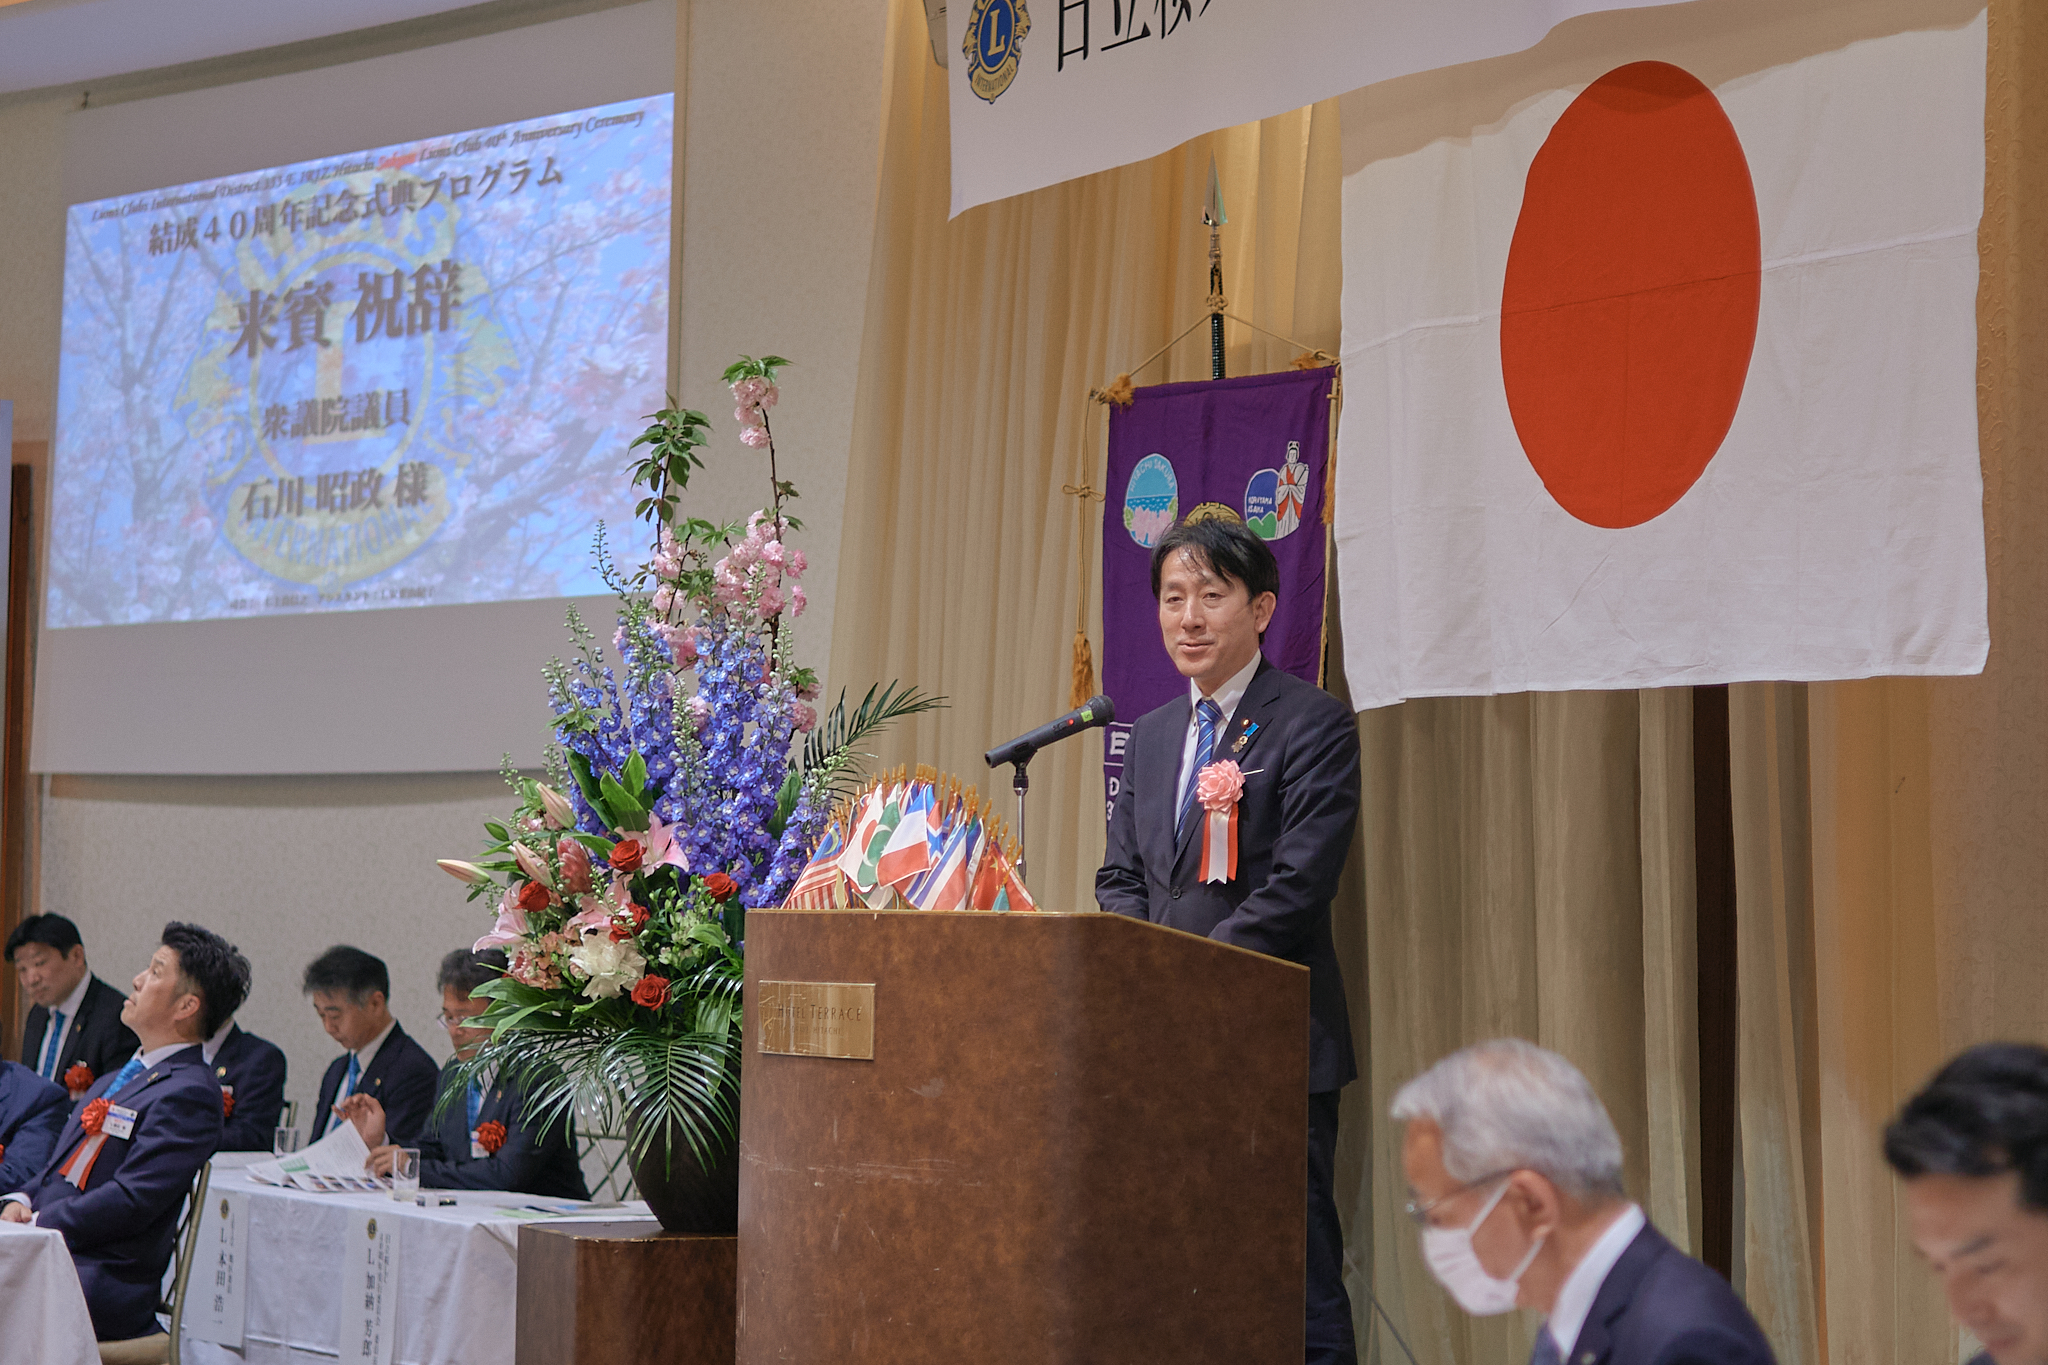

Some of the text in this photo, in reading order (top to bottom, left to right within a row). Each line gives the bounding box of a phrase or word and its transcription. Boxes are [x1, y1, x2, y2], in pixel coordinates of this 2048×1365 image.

[454, 135, 482, 156] Club
[509, 122, 583, 147] Anniversary
[585, 111, 645, 133] Ceremony
[228, 258, 463, 358] 来賓 祝辞
[262, 387, 411, 440] 衆議院議員
[240, 460, 429, 522] 石川 昭政 様
[1130, 458, 1175, 492] HITACHI SAKURA
[1247, 496, 1273, 505] KORIYAMA
[811, 1003, 863, 1022] TERRACE
